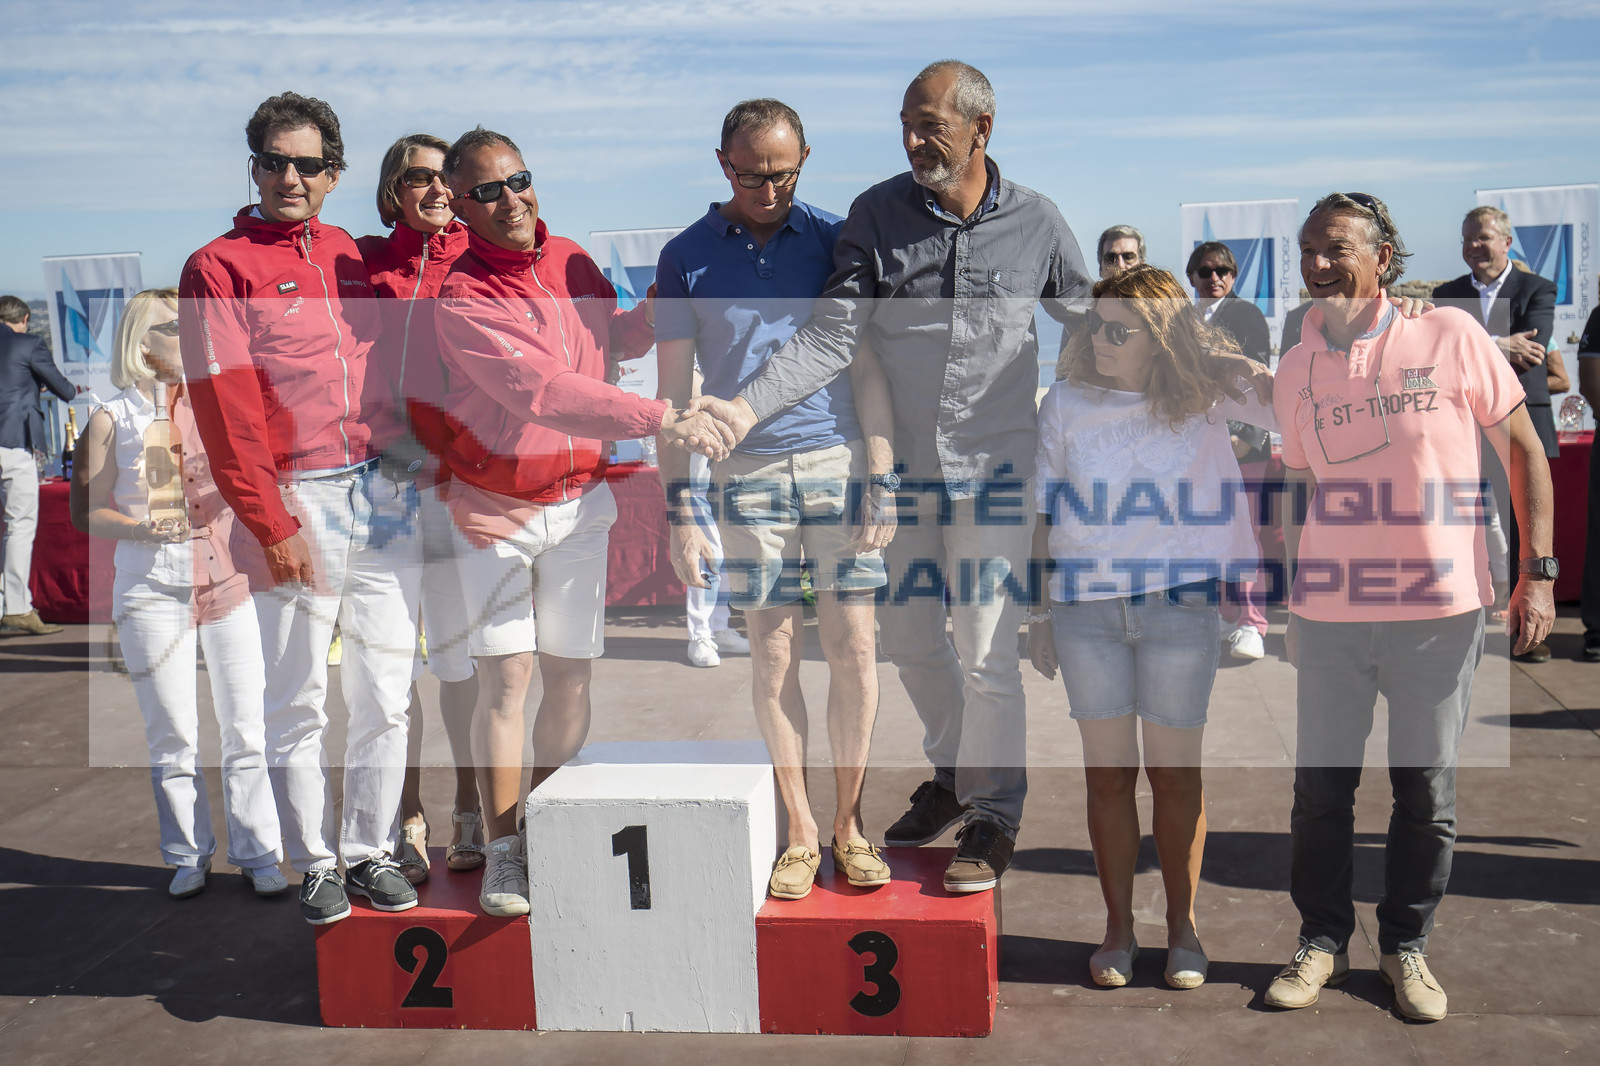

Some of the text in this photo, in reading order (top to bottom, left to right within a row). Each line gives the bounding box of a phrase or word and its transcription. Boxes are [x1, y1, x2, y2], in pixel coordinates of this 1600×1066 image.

[612, 825, 651, 910] 1
[393, 926, 454, 1009] 2
[847, 930, 901, 1018] 3
